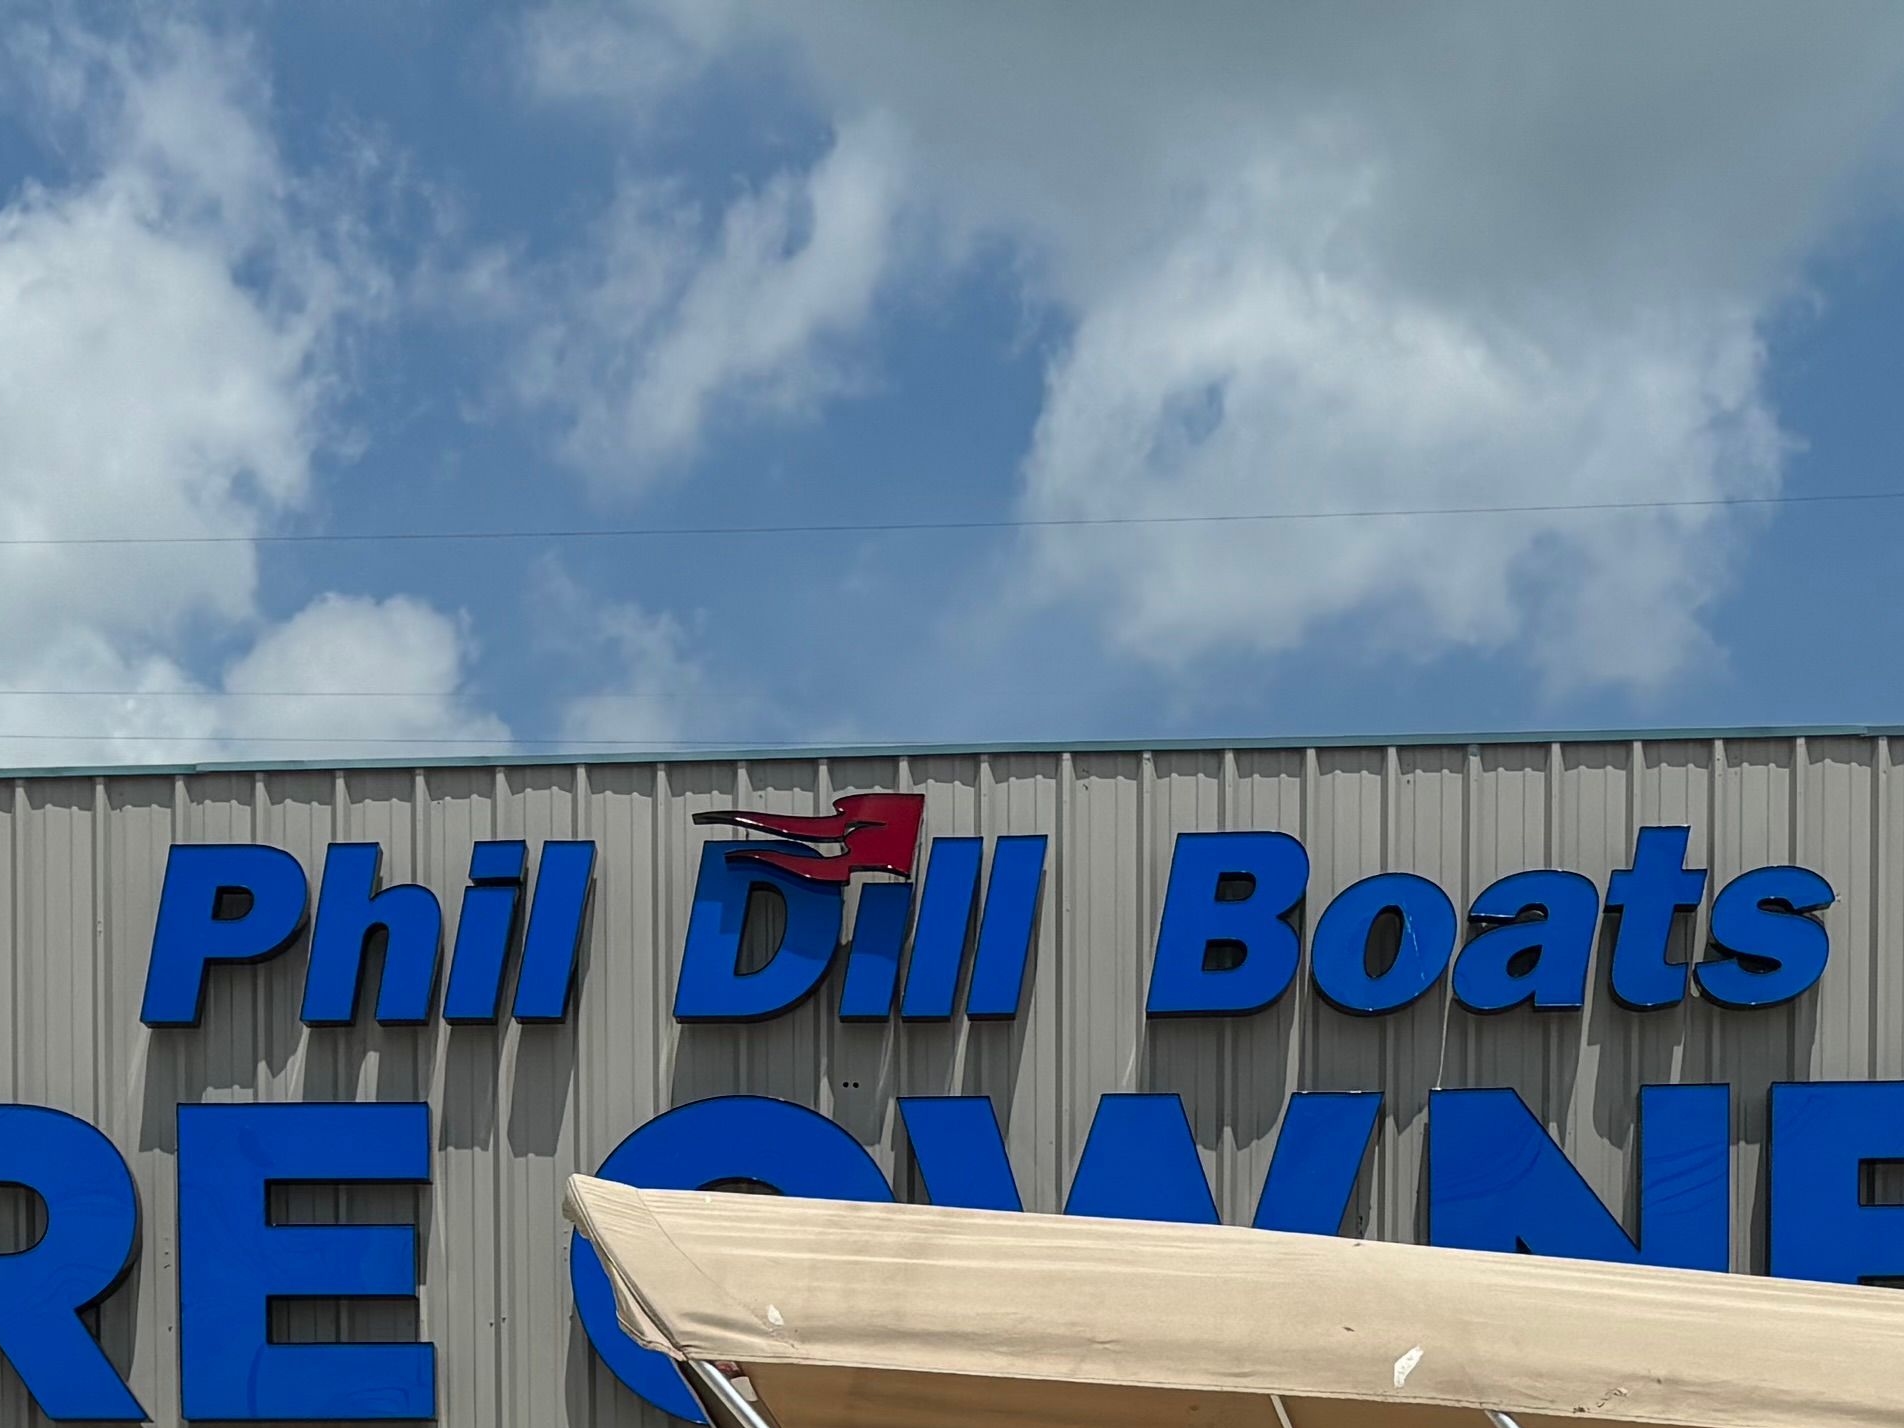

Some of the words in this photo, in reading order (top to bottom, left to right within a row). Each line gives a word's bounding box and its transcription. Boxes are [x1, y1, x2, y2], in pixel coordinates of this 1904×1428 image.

[142, 842, 594, 1024] Phil
[672, 836, 1047, 1019] Dill
[1145, 827, 1835, 1015] Boats
